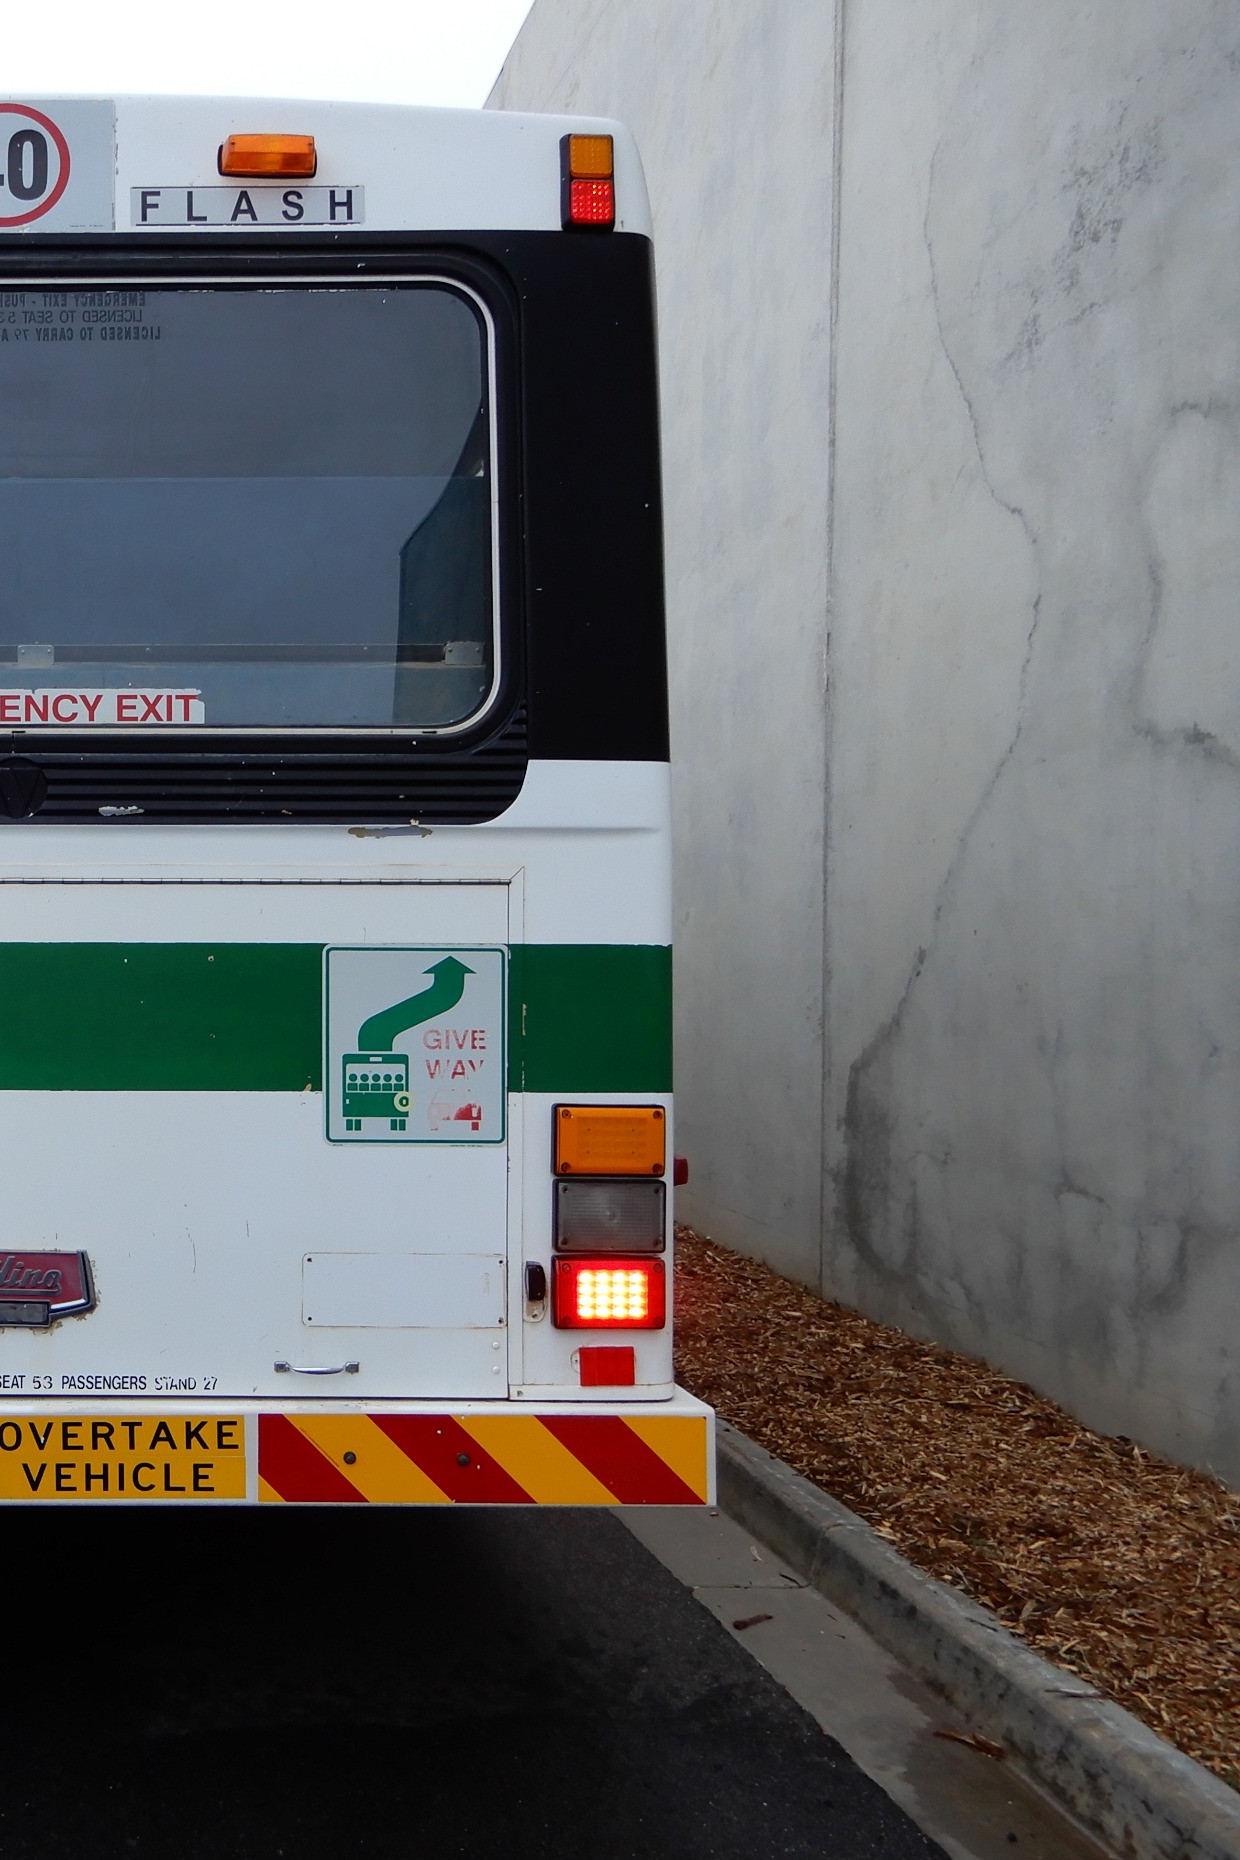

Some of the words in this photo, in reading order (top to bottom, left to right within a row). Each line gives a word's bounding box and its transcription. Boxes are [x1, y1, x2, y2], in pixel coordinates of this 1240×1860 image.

[140, 190, 355, 221] FLASH
[116, 694, 200, 722] EXIT
[423, 1029, 487, 1050] GIVE
[32, 1376, 53, 1389] 53
[61, 1375, 147, 1390] PASSENGERS
[154, 1376, 197, 1390] STAND
[22, 1462, 215, 1492] VEHICLE
